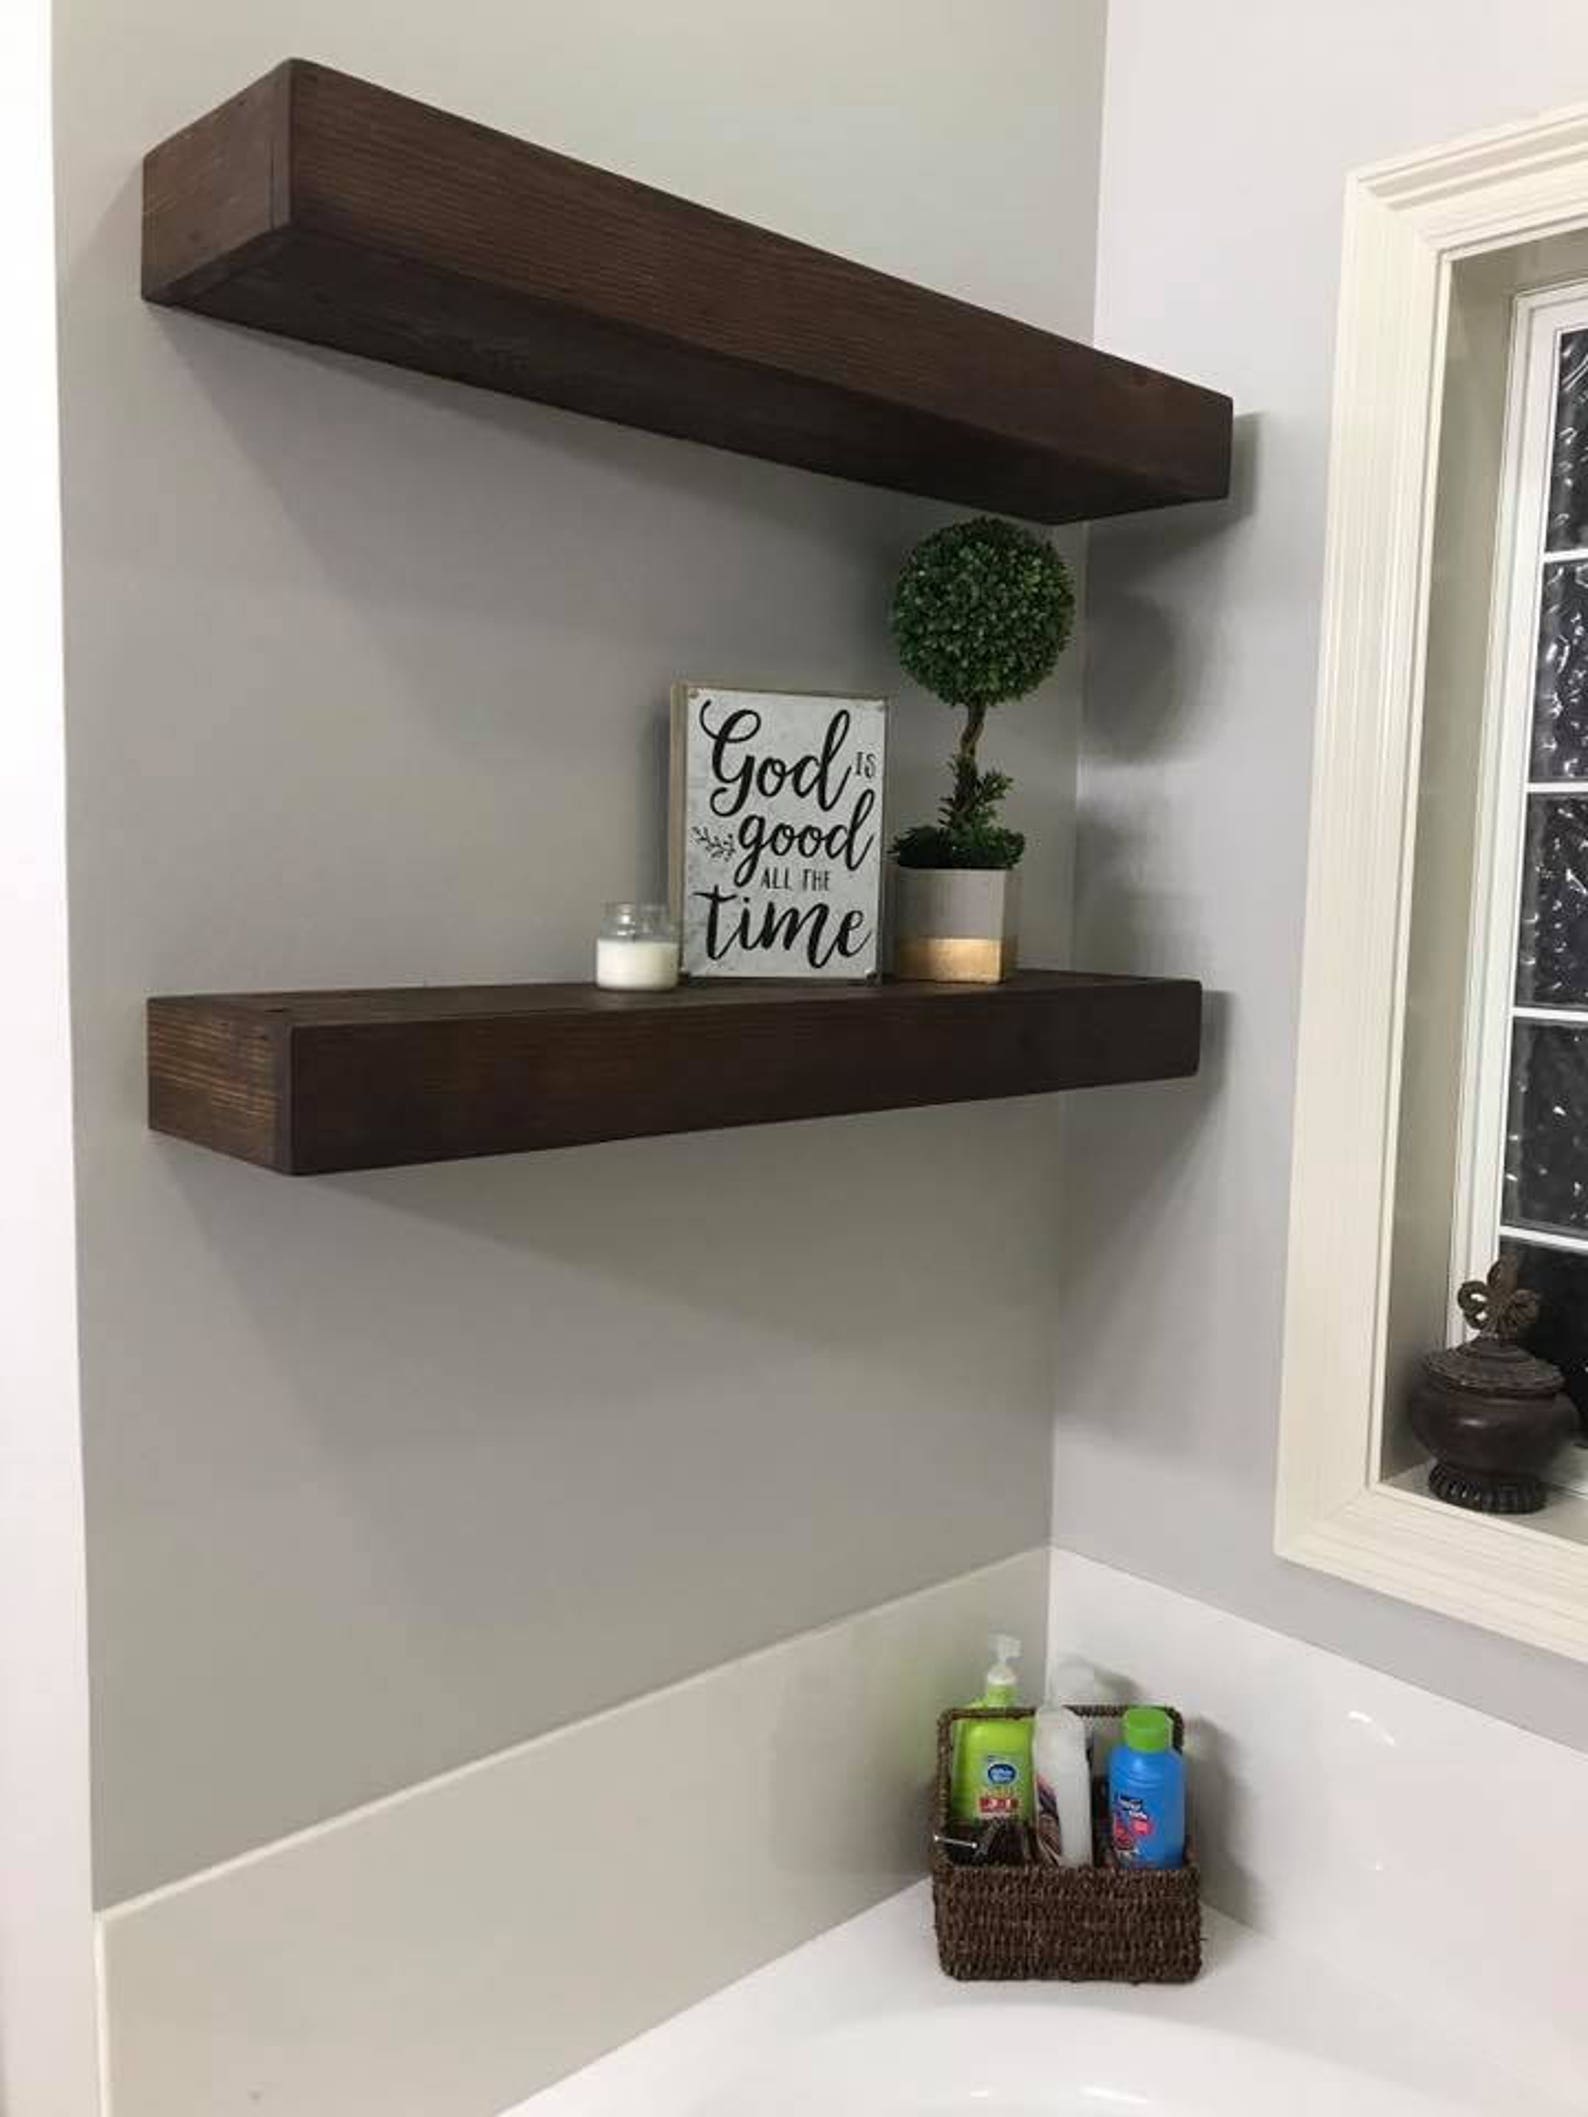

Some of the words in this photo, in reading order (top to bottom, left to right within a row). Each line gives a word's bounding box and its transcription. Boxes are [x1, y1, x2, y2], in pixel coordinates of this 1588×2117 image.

[699, 700, 852, 817] God
[855, 751, 876, 779] IS
[734, 789, 875, 887] good
[760, 867, 793, 890] ALL
[803, 868, 831, 892] THE
[692, 885, 873, 969] time
